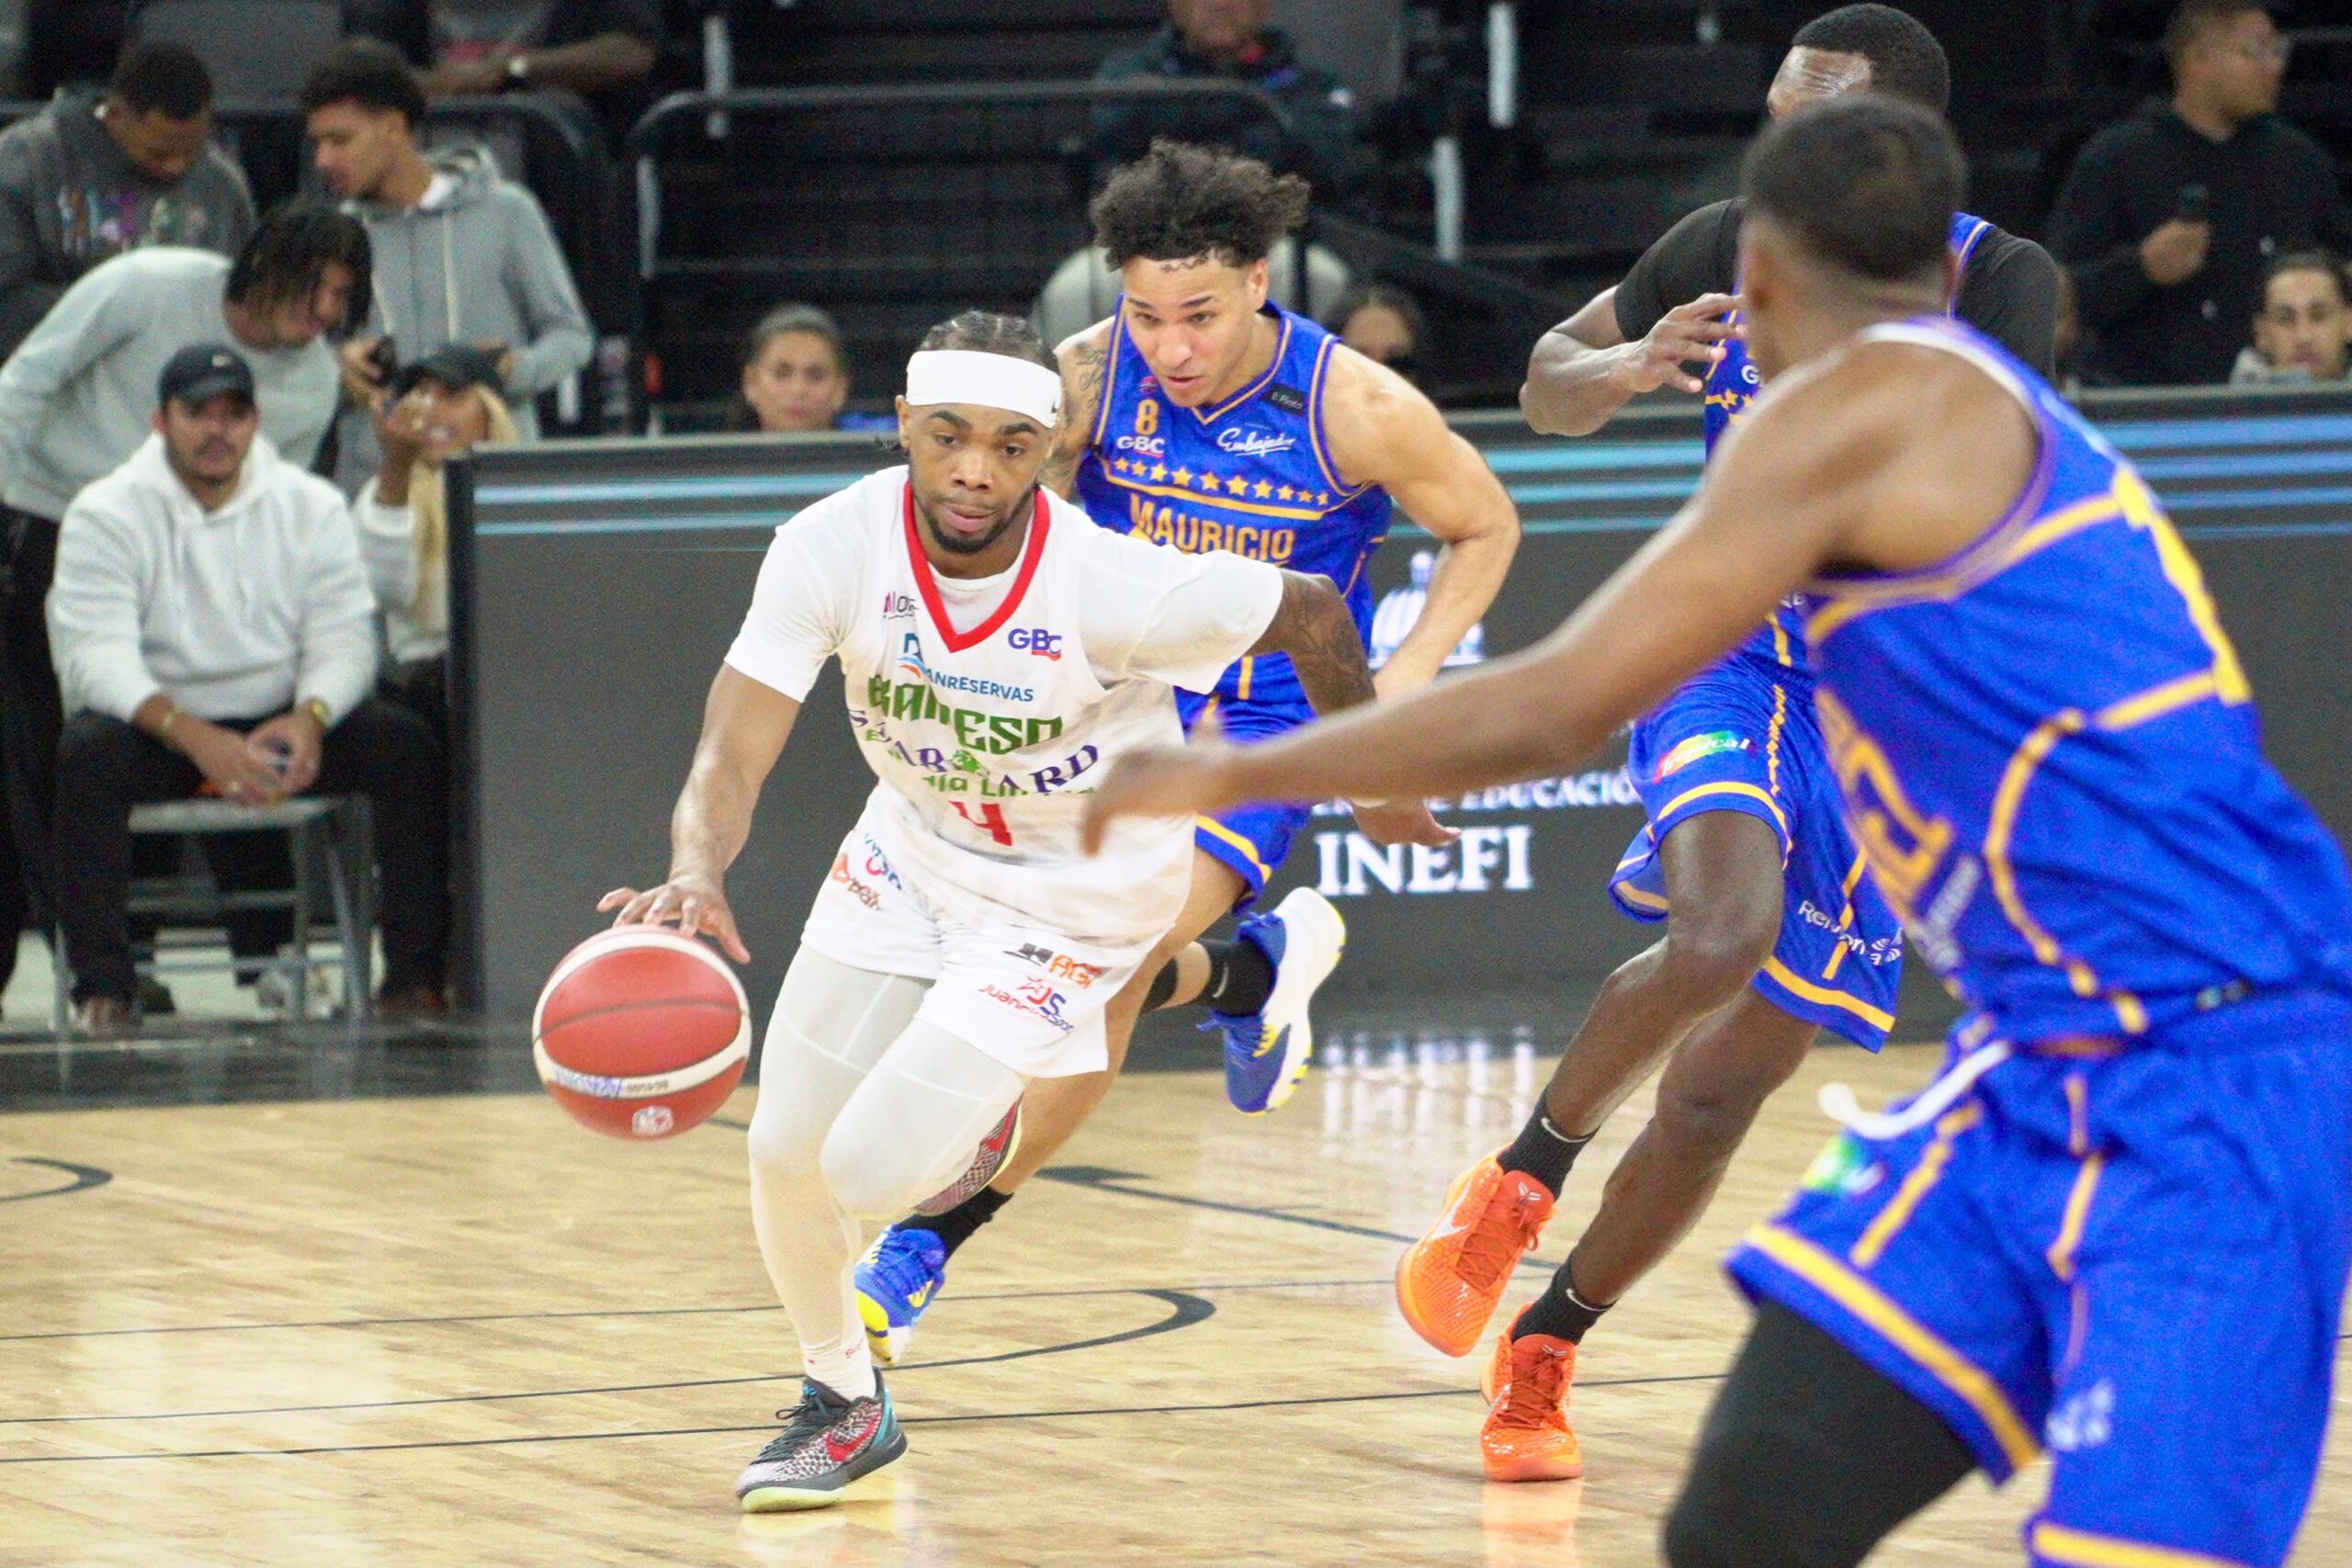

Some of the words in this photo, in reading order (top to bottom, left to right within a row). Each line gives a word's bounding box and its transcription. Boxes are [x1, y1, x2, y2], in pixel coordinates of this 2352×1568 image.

[1135, 399, 1159, 435] 8
[1116, 435, 1166, 457] GBC
[1129, 492, 1295, 561] MAURICIO
[1007, 627, 1062, 657] GBC
[922, 667, 1034, 703] ANRESERVAS
[948, 800, 1013, 847] 4
[1315, 826, 1533, 897] INEFI
